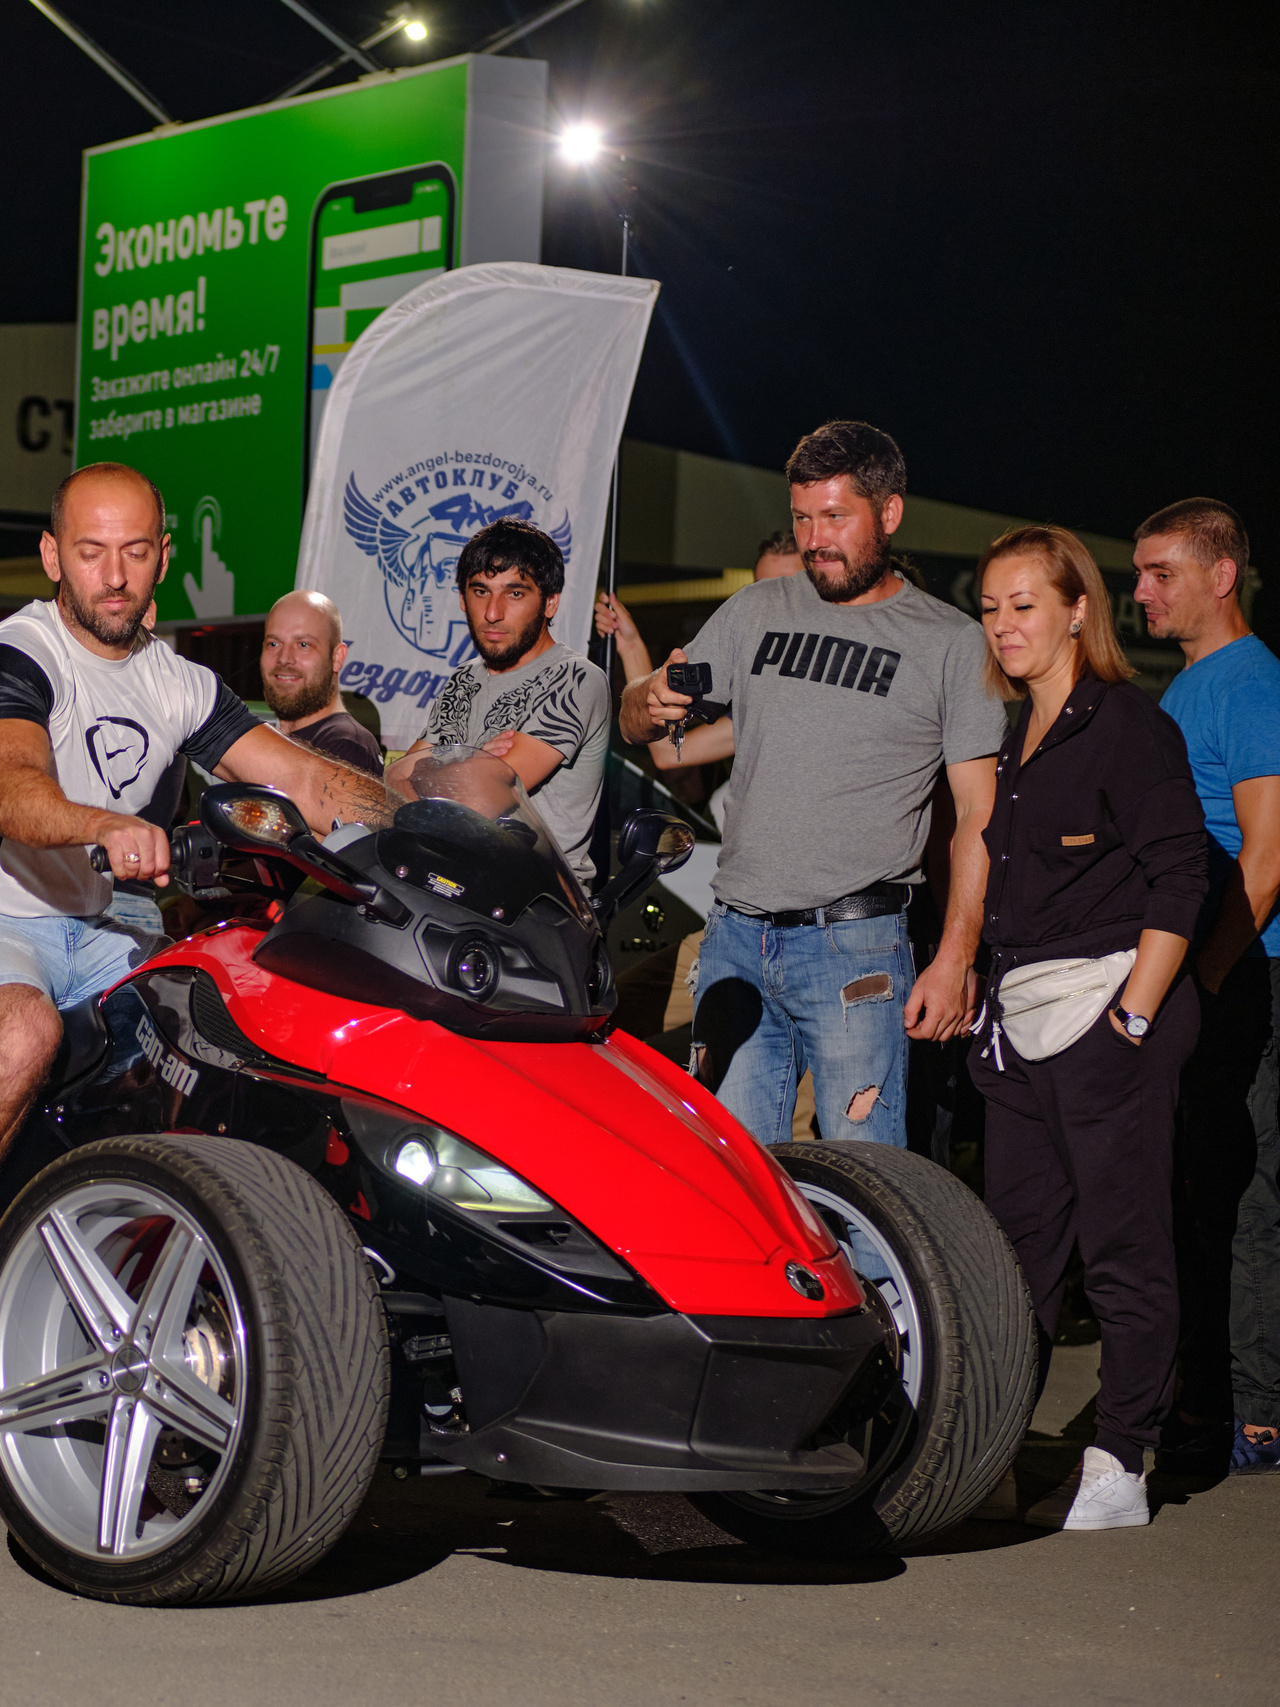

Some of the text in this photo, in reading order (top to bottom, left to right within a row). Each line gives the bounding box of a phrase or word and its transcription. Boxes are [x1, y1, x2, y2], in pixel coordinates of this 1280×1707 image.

[94, 195, 288, 277] Экономьте
[92, 275, 207, 361] время!
[91, 344, 280, 402] Закажите онлайн 24/7
[89, 393, 261, 440] заберите в магазине
[372, 450, 553, 503] www.angel-bezdorojya.ru
[385, 468, 519, 518] АВТОКЛУБ
[751, 631, 901, 697] PUMA
[135, 1014, 200, 1098] can-am
